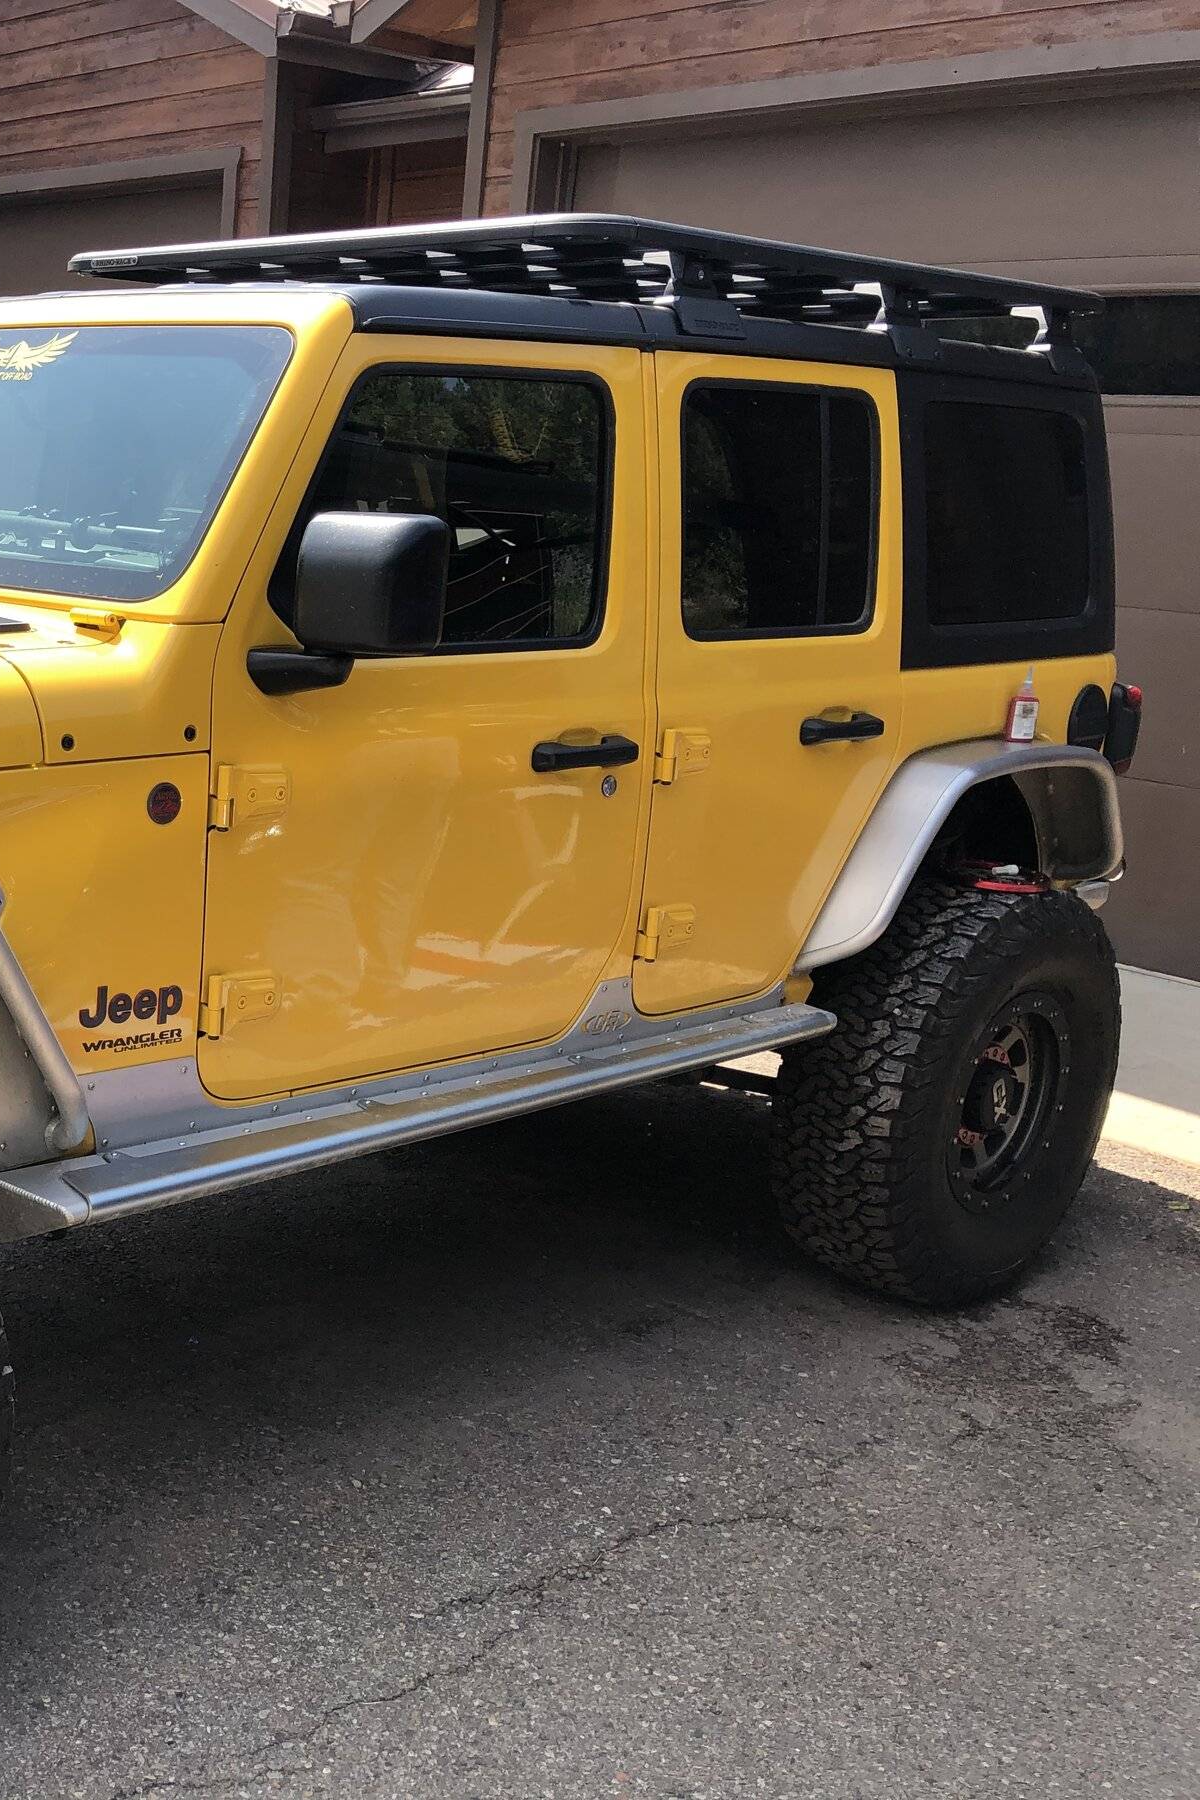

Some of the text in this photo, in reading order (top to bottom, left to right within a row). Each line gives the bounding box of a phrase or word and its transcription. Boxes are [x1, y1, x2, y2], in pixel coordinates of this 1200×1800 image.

[79, 985, 183, 1028] Jeep
[82, 1028, 183, 1053] WRANGLER
[114, 1037, 183, 1053] UNLIMITED
